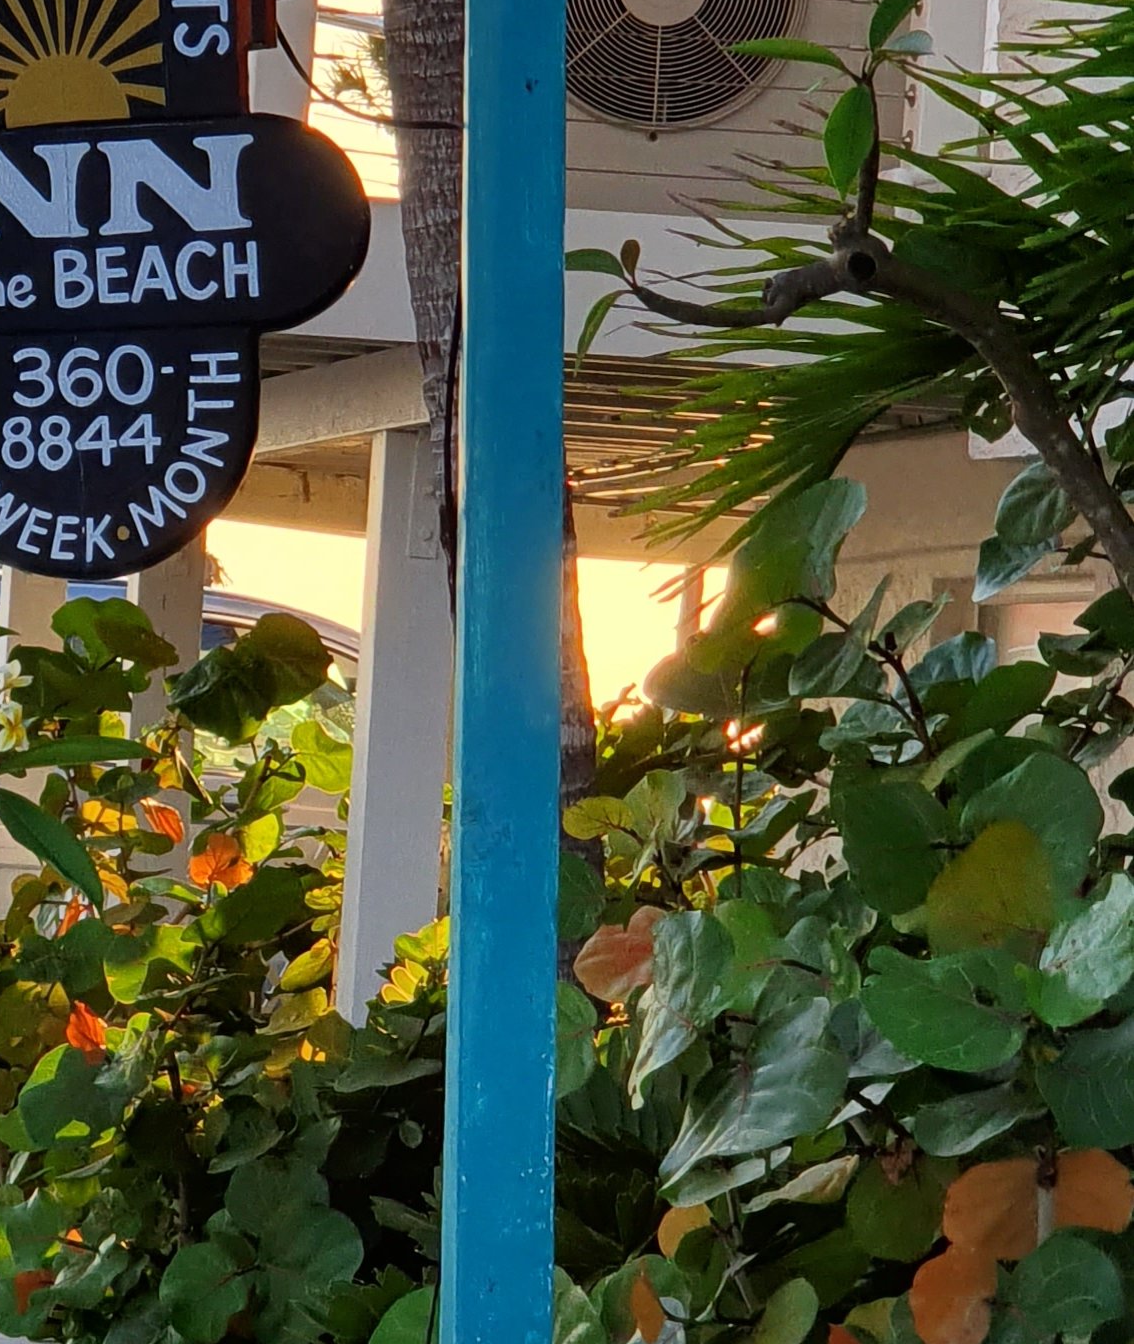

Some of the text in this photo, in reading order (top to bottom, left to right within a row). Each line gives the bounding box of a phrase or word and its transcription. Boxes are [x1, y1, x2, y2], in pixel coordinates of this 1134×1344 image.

[53, 240, 260, 309] BEACH
[12, 344, 175, 408] 360-
[1, 413, 162, 472] 8844
[128, 351, 241, 547] MONTH
